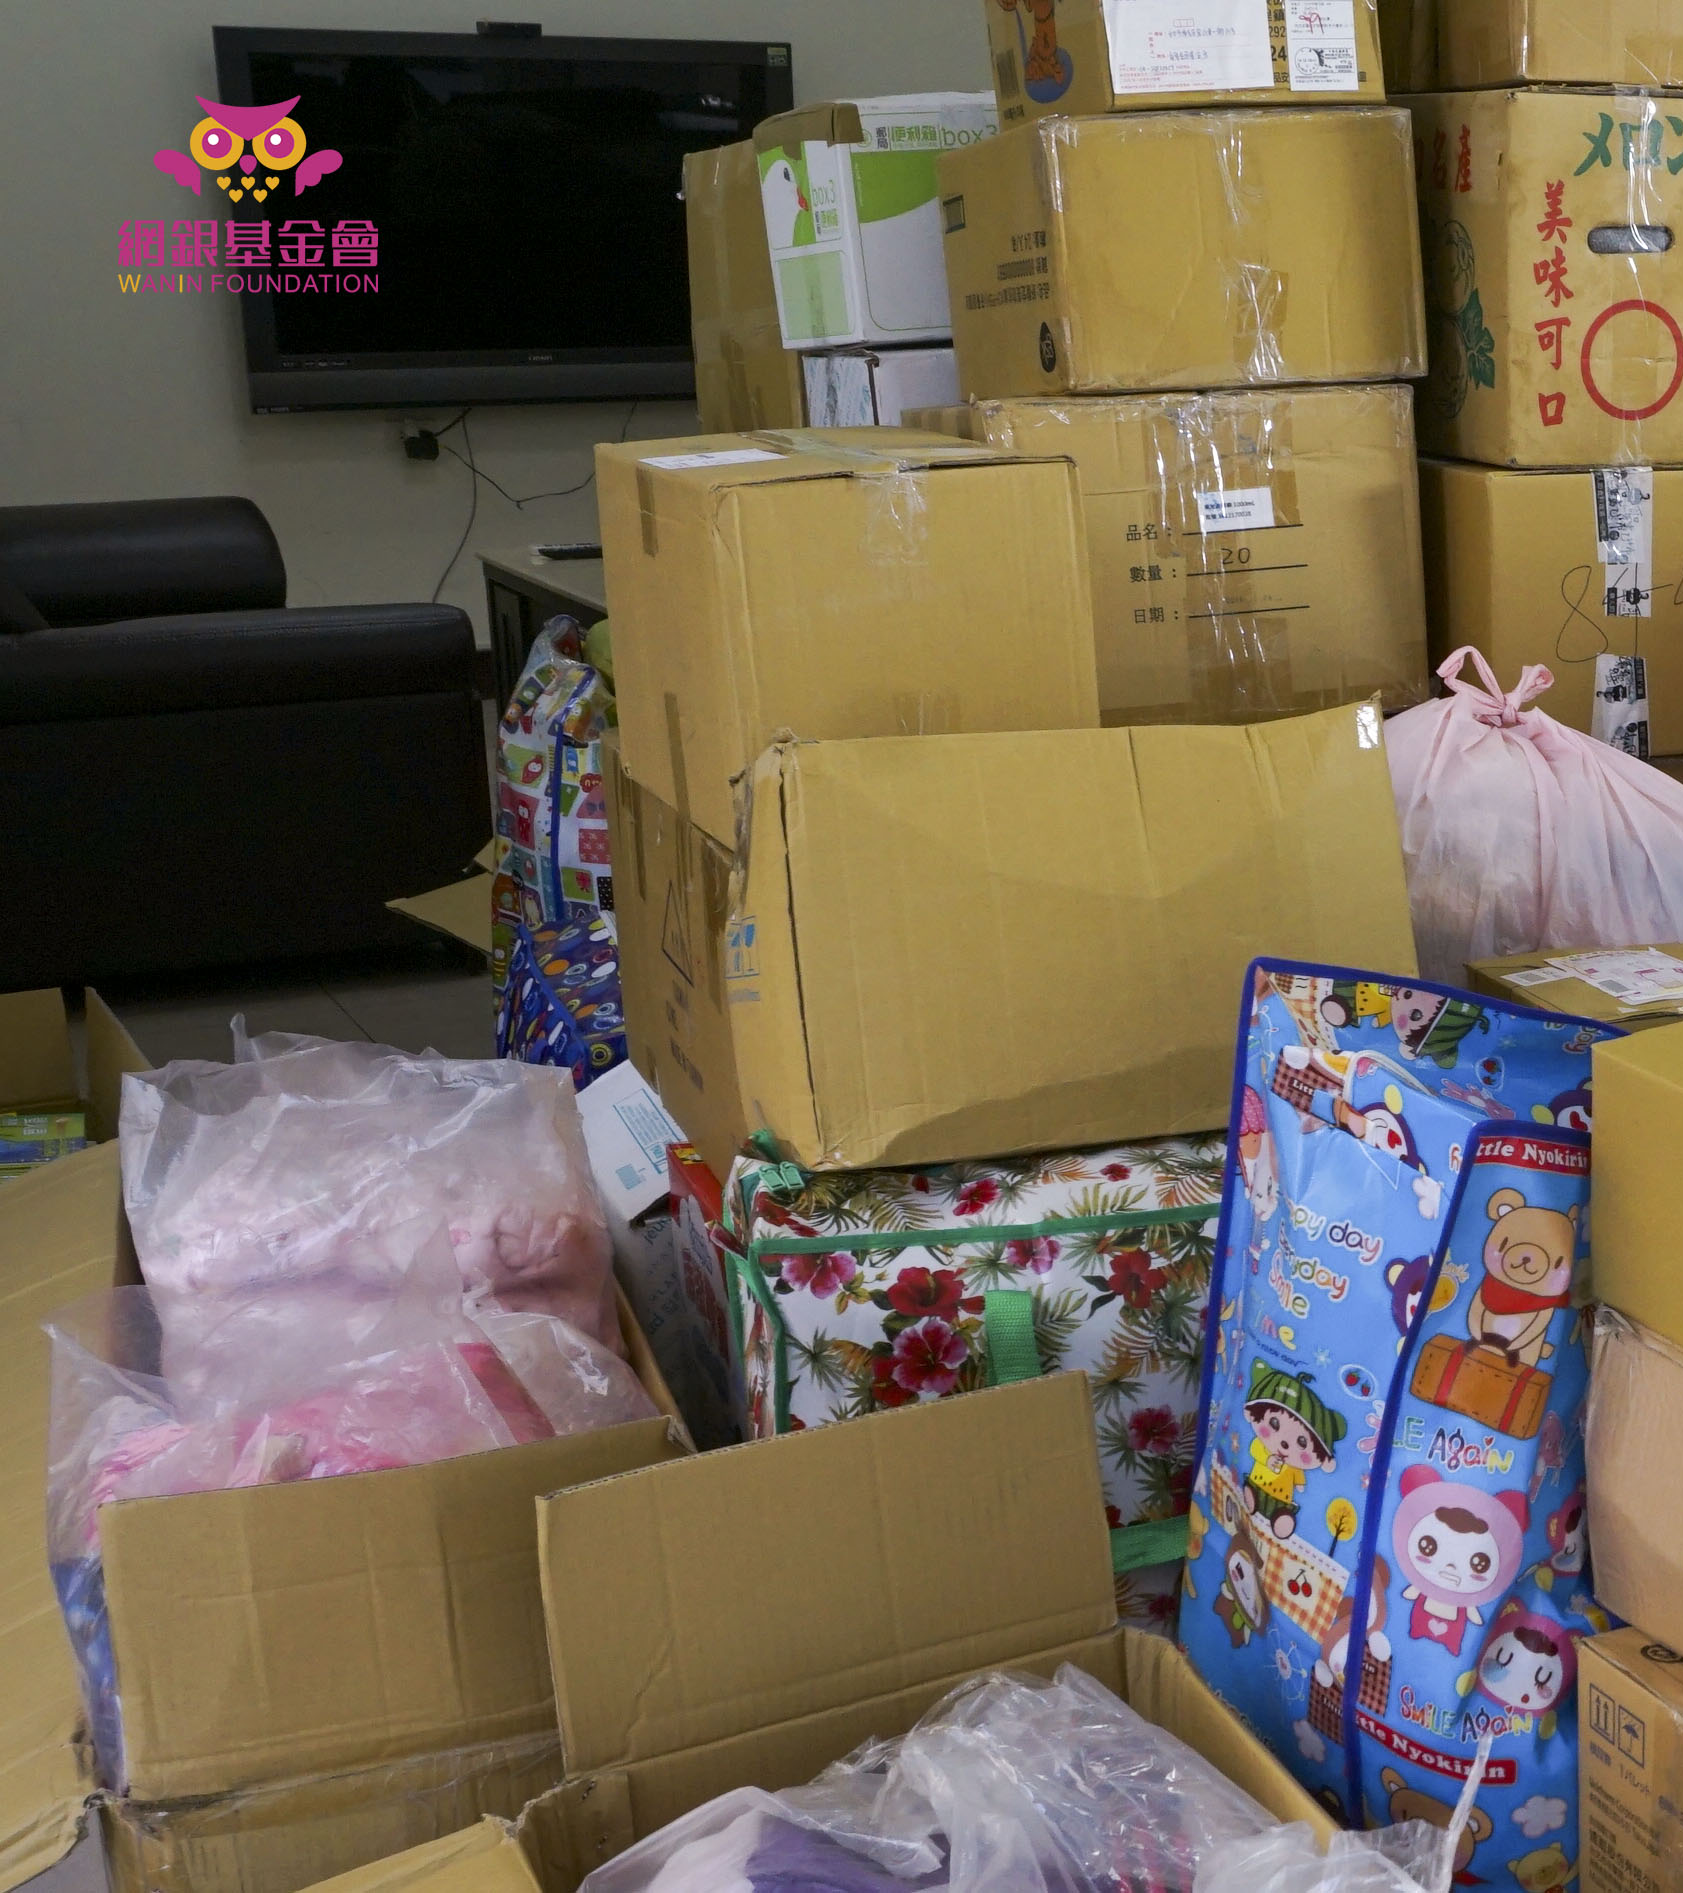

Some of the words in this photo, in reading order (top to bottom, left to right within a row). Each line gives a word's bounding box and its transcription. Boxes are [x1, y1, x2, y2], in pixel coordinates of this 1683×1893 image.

[1533, 179, 1574, 426] 美味可口
[1220, 546, 1251, 565] 20
[1328, 1219, 1386, 1264] day
